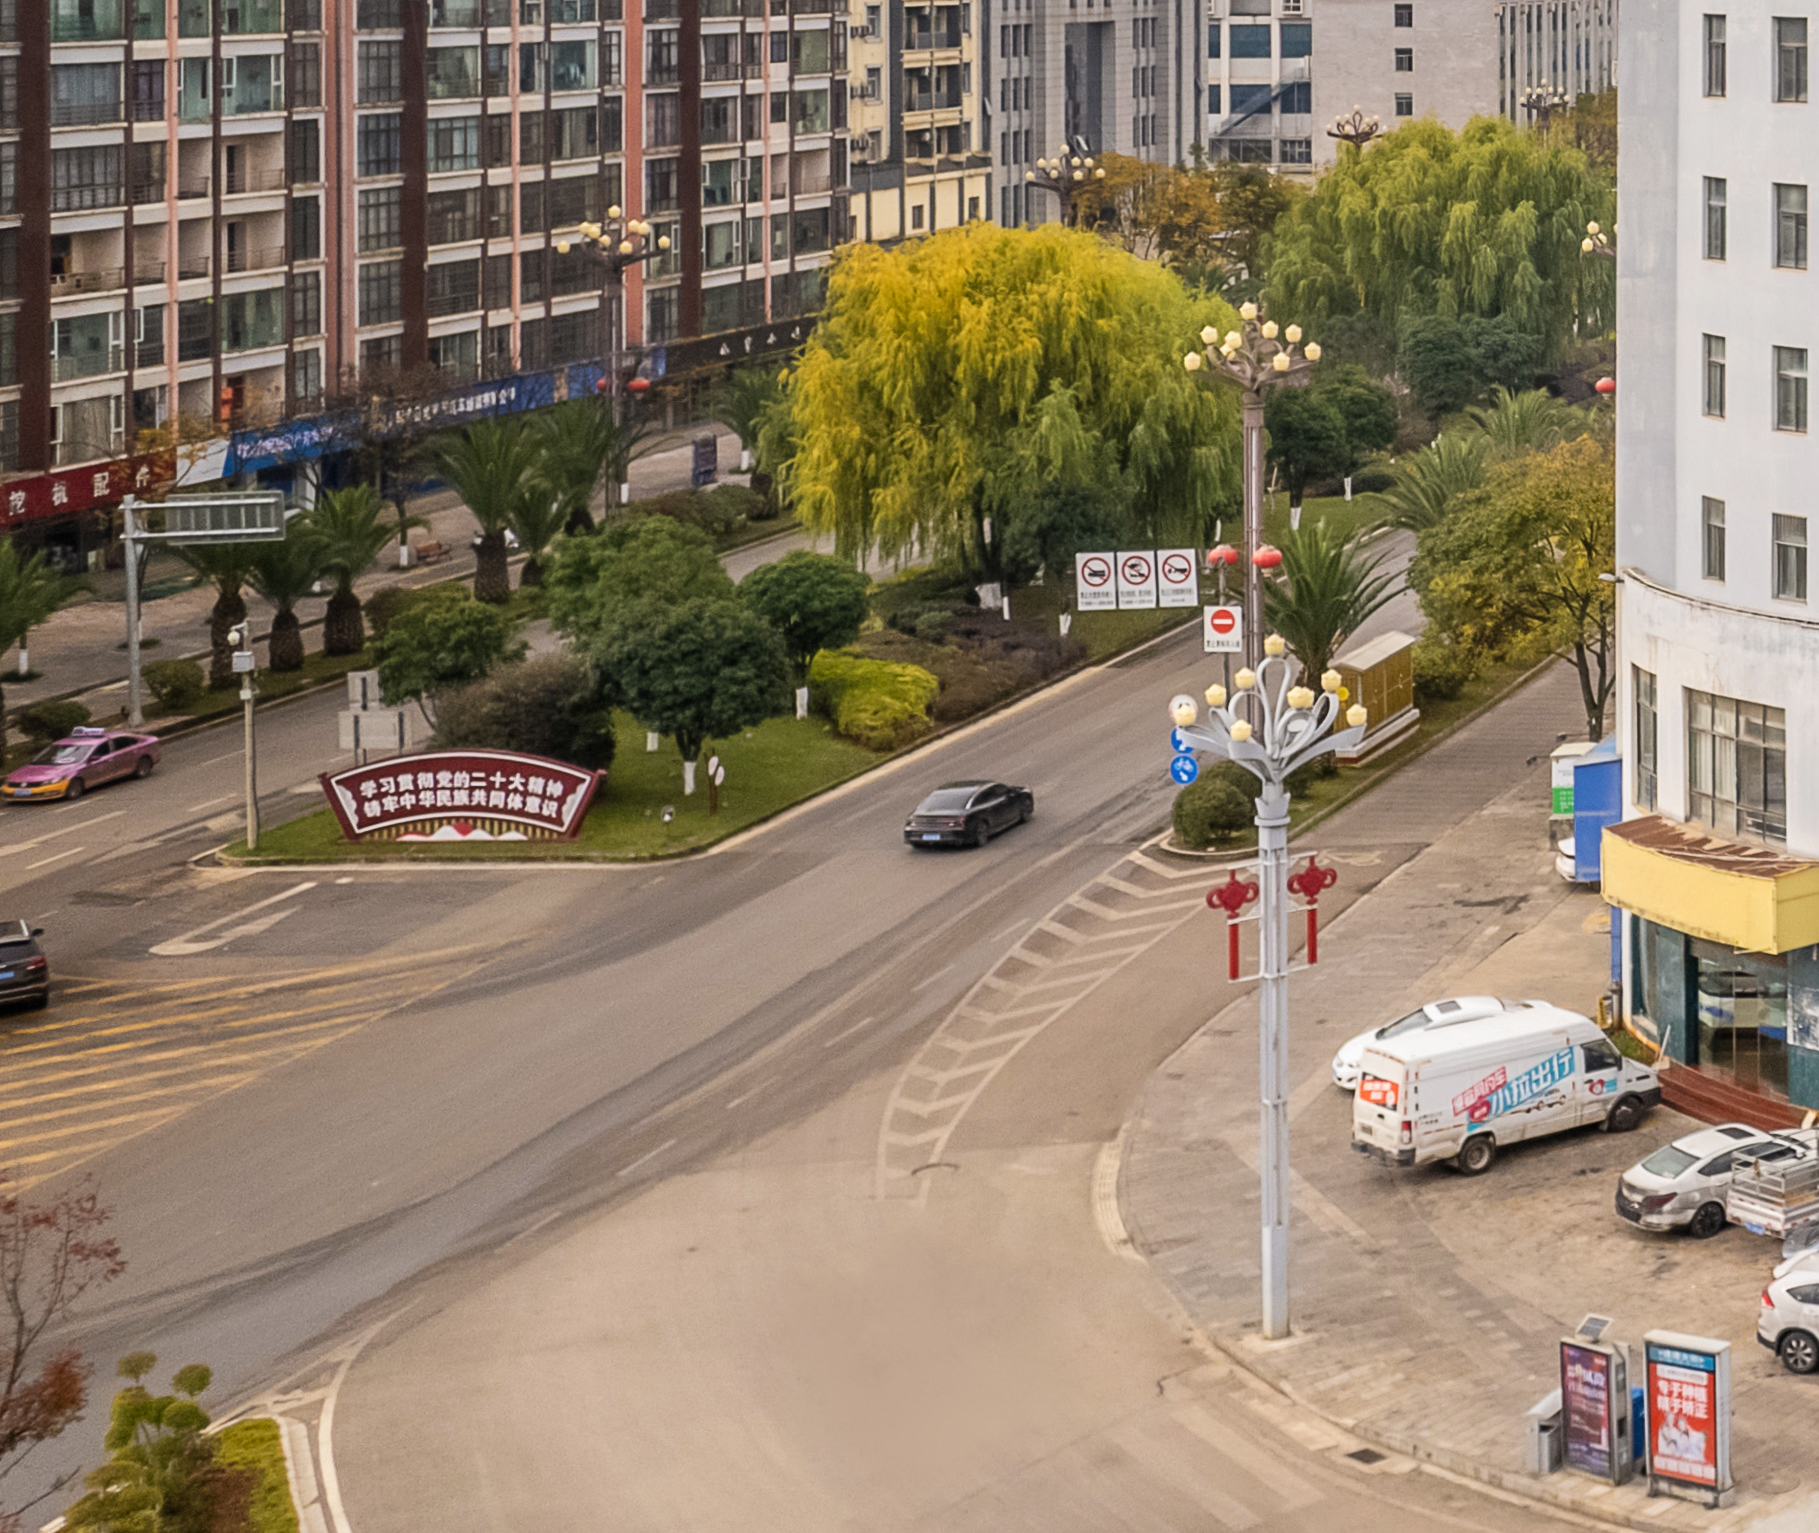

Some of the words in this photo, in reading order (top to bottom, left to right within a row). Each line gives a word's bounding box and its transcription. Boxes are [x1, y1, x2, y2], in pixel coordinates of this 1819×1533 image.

[360, 771, 564, 798] 学习贯彻党的二十大精神
